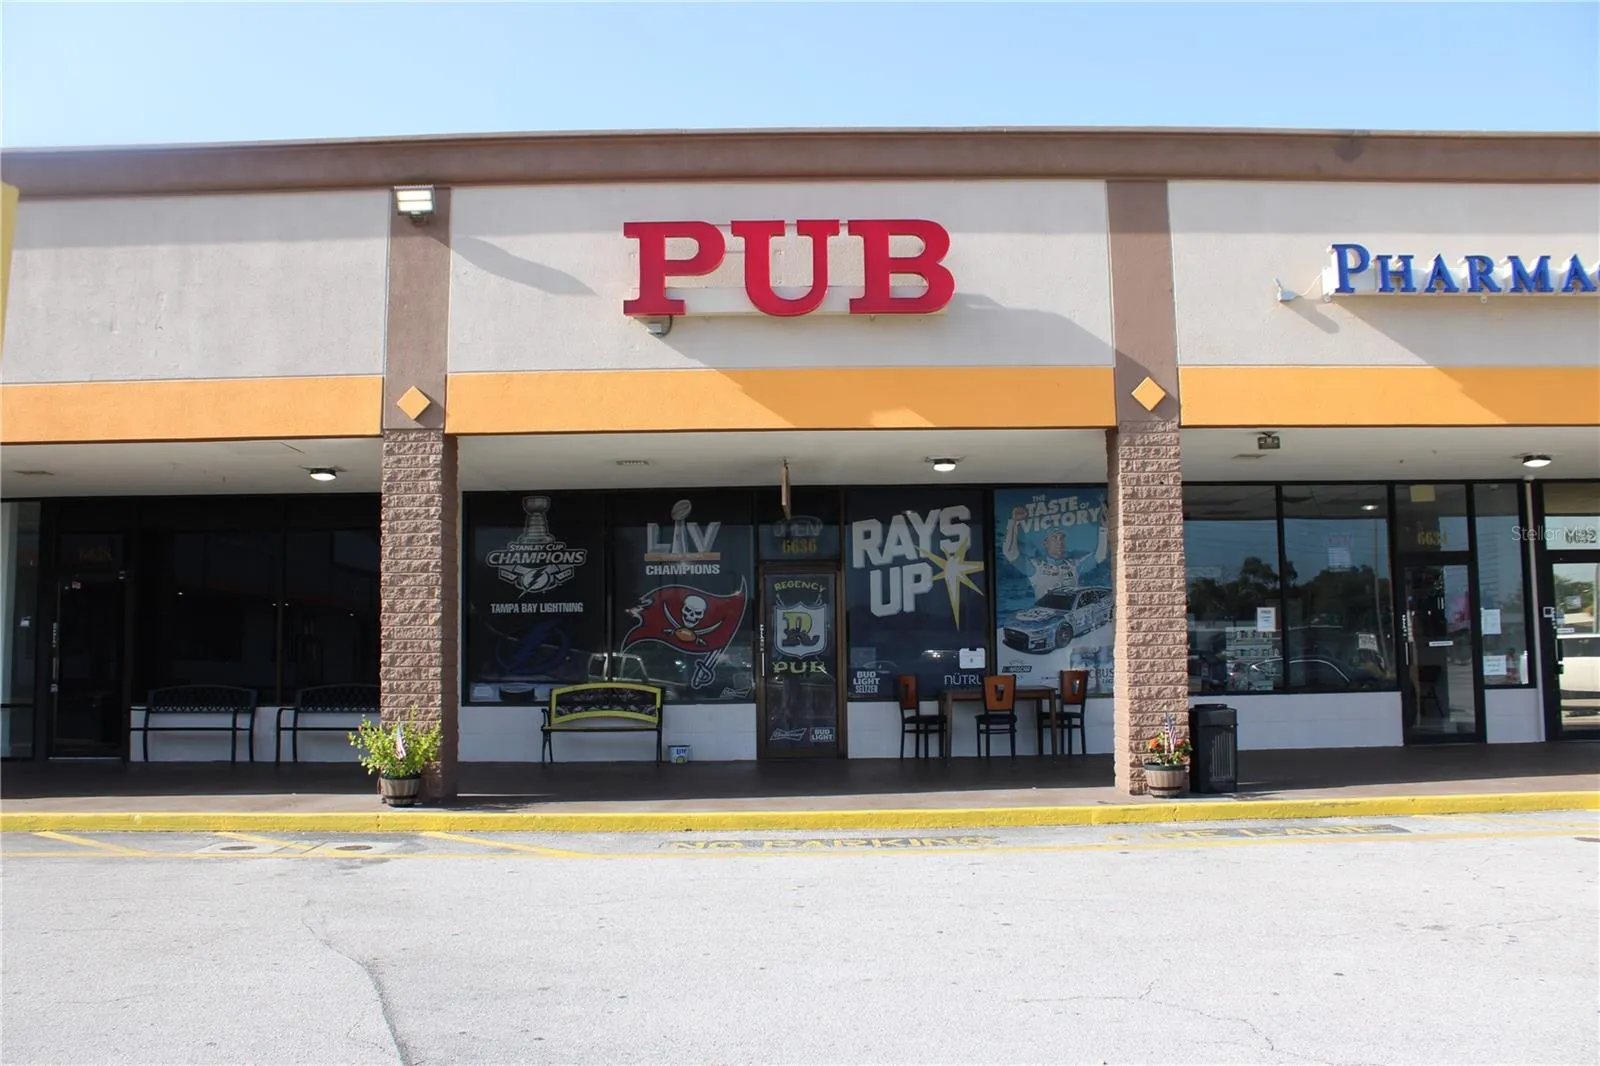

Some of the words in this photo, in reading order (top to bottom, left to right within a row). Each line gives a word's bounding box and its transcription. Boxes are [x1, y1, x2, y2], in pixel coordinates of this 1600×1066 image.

[623, 219, 956, 317] PUB
[1331, 243, 1600, 294] PHARMA
[1025, 496, 1079, 517] TASTE
[1021, 507, 1101, 533] VICTORY
[852, 504, 972, 569] RAYS
[546, 543, 564, 551] CUP
[489, 551, 585, 564] CHAMPIONS
[645, 563, 721, 576] CHAMPIONS
[774, 580, 827, 593] REGENCY
[869, 562, 934, 617] UP
[491, 603, 519, 613] TAMPA
[521, 603, 538, 613] BAY
[540, 602, 584, 613] LIGHTNING
[771, 660, 826, 674] PUB
[856, 670, 877, 678] BUD
[853, 677, 880, 685] LIGHT
[855, 685, 878, 694] SELTZER
[761, 836, 994, 849] PARKING
